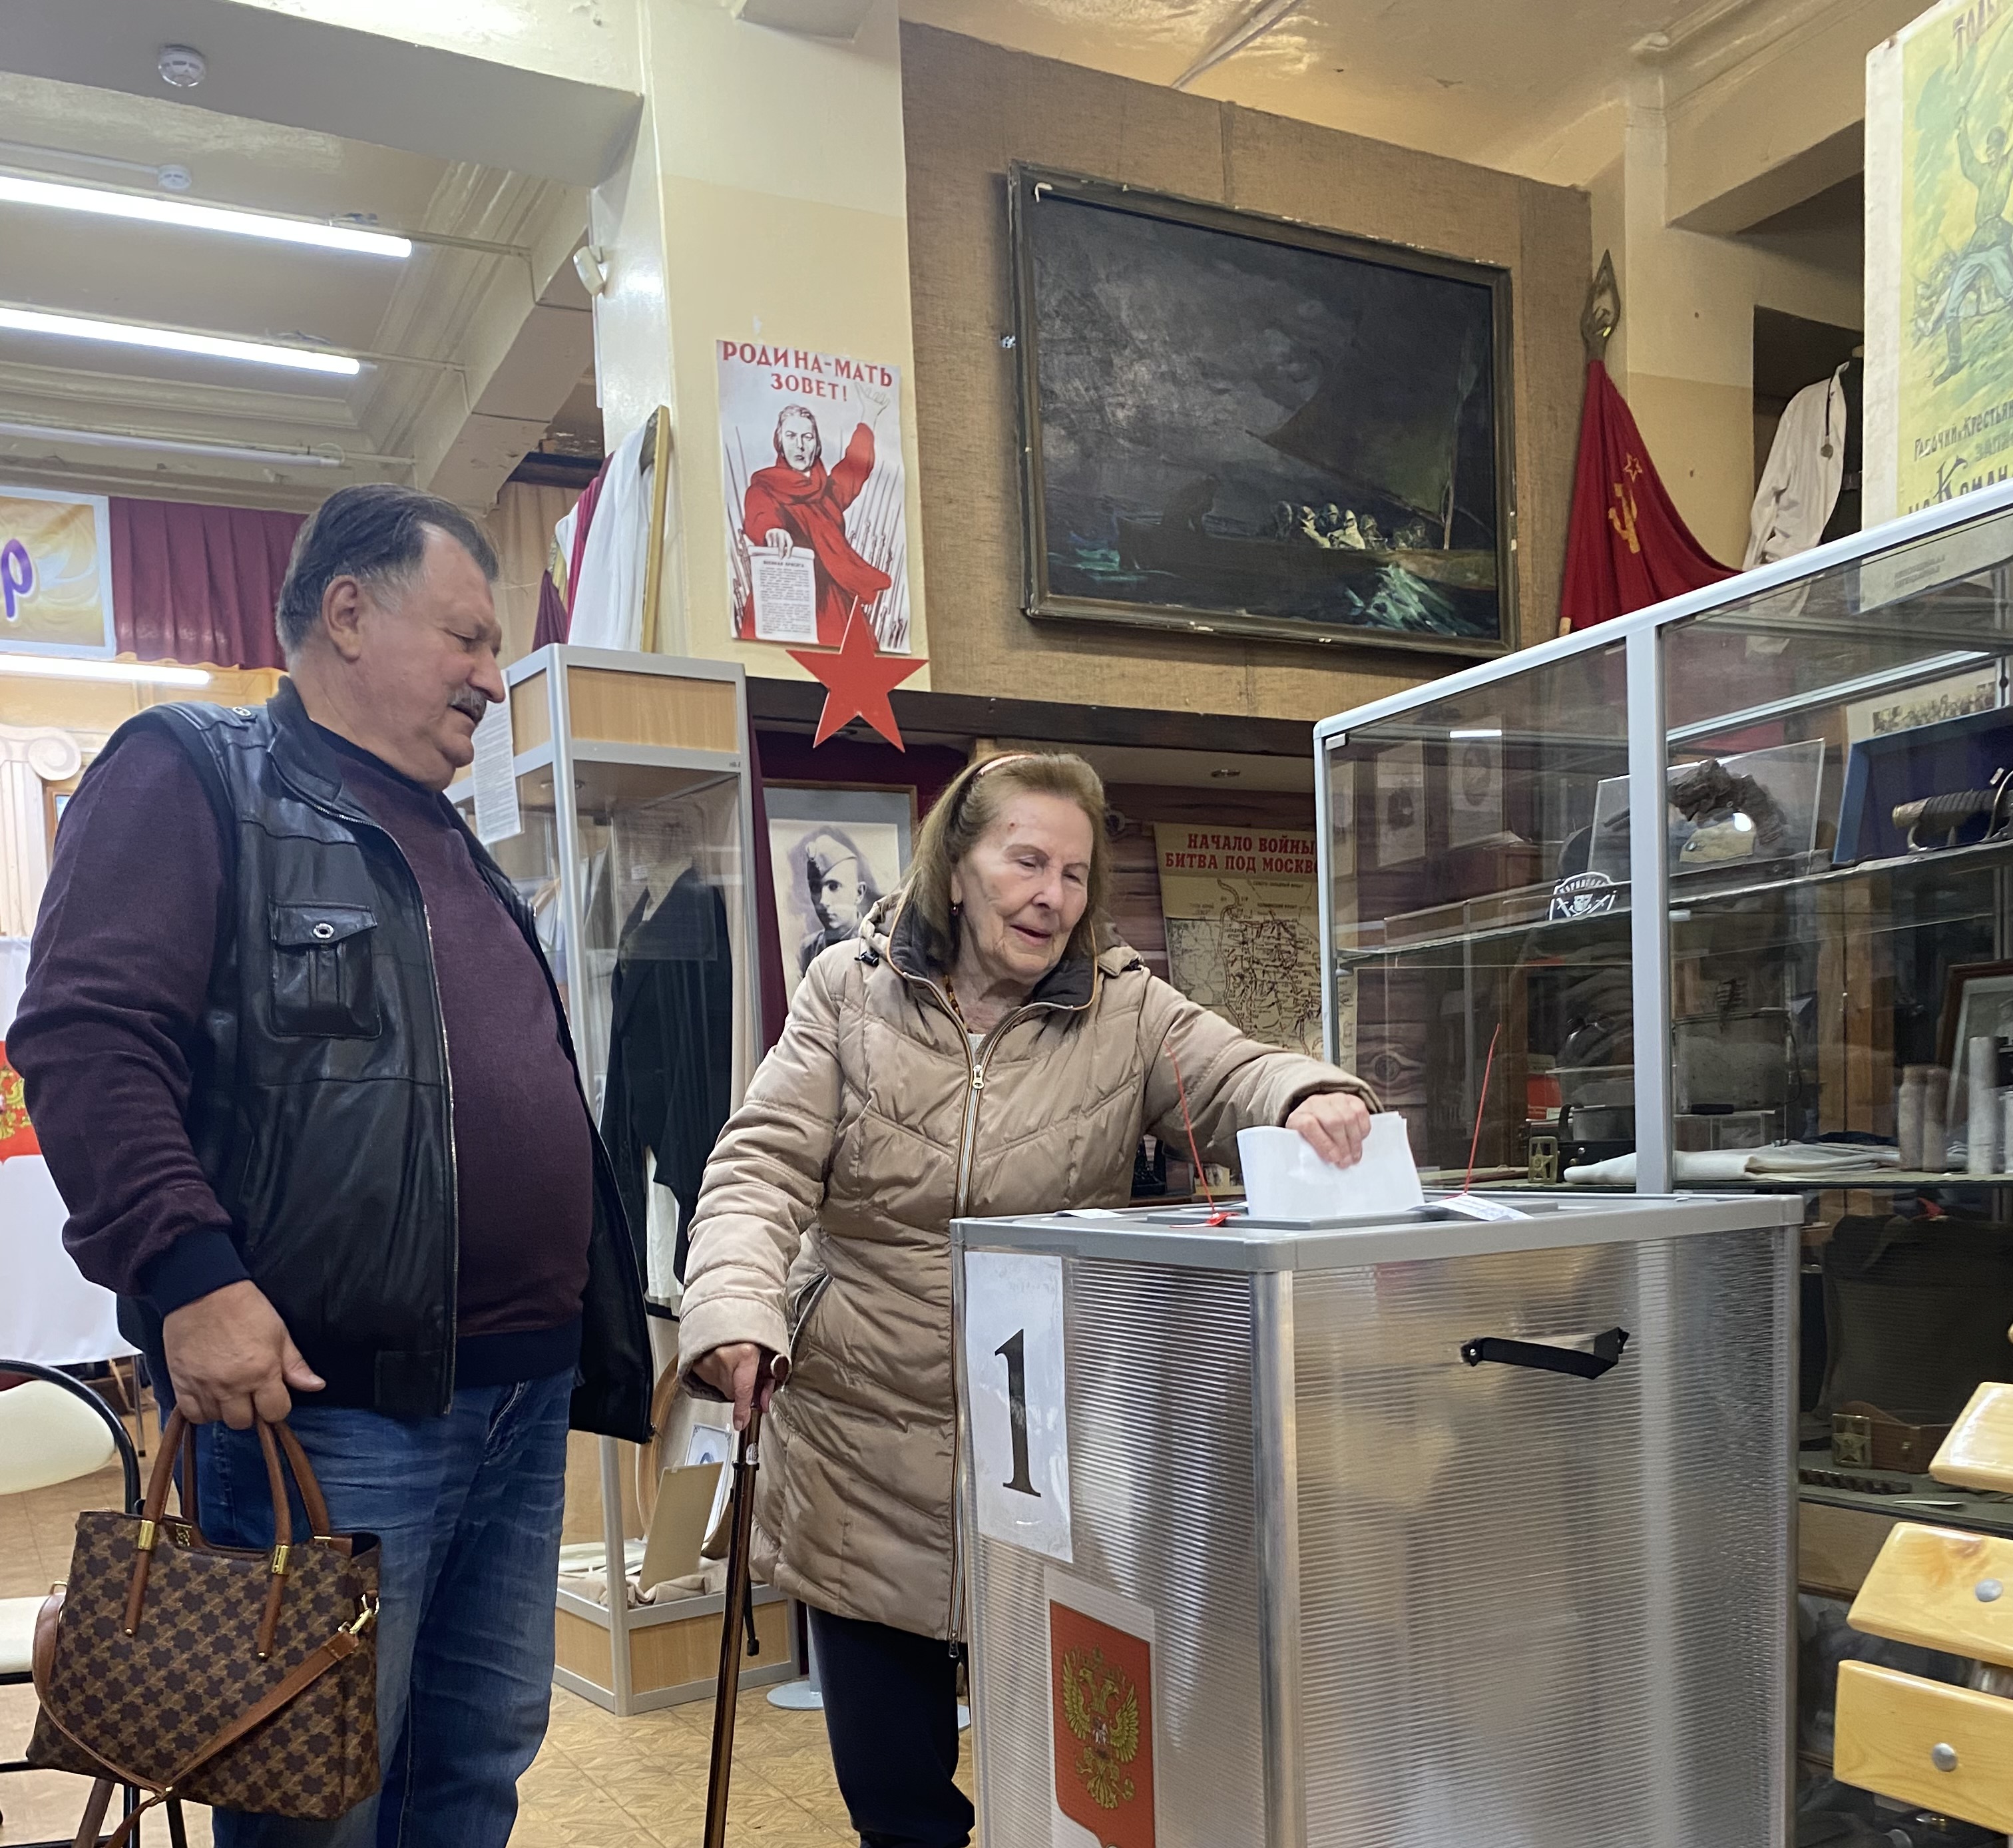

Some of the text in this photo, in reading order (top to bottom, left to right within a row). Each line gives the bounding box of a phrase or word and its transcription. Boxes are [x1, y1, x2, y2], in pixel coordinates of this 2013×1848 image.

[723, 340, 893, 387] РОДИНА-МАТЬ
[771, 373, 847, 401] ЗОВЕТ!
[1188, 833, 1315, 855] НАЧАЛО ВОЙНЫ
[1165, 852, 1317, 874] БИТВА ПОД МОСКВ
[995, 1328, 1042, 1498] 1
